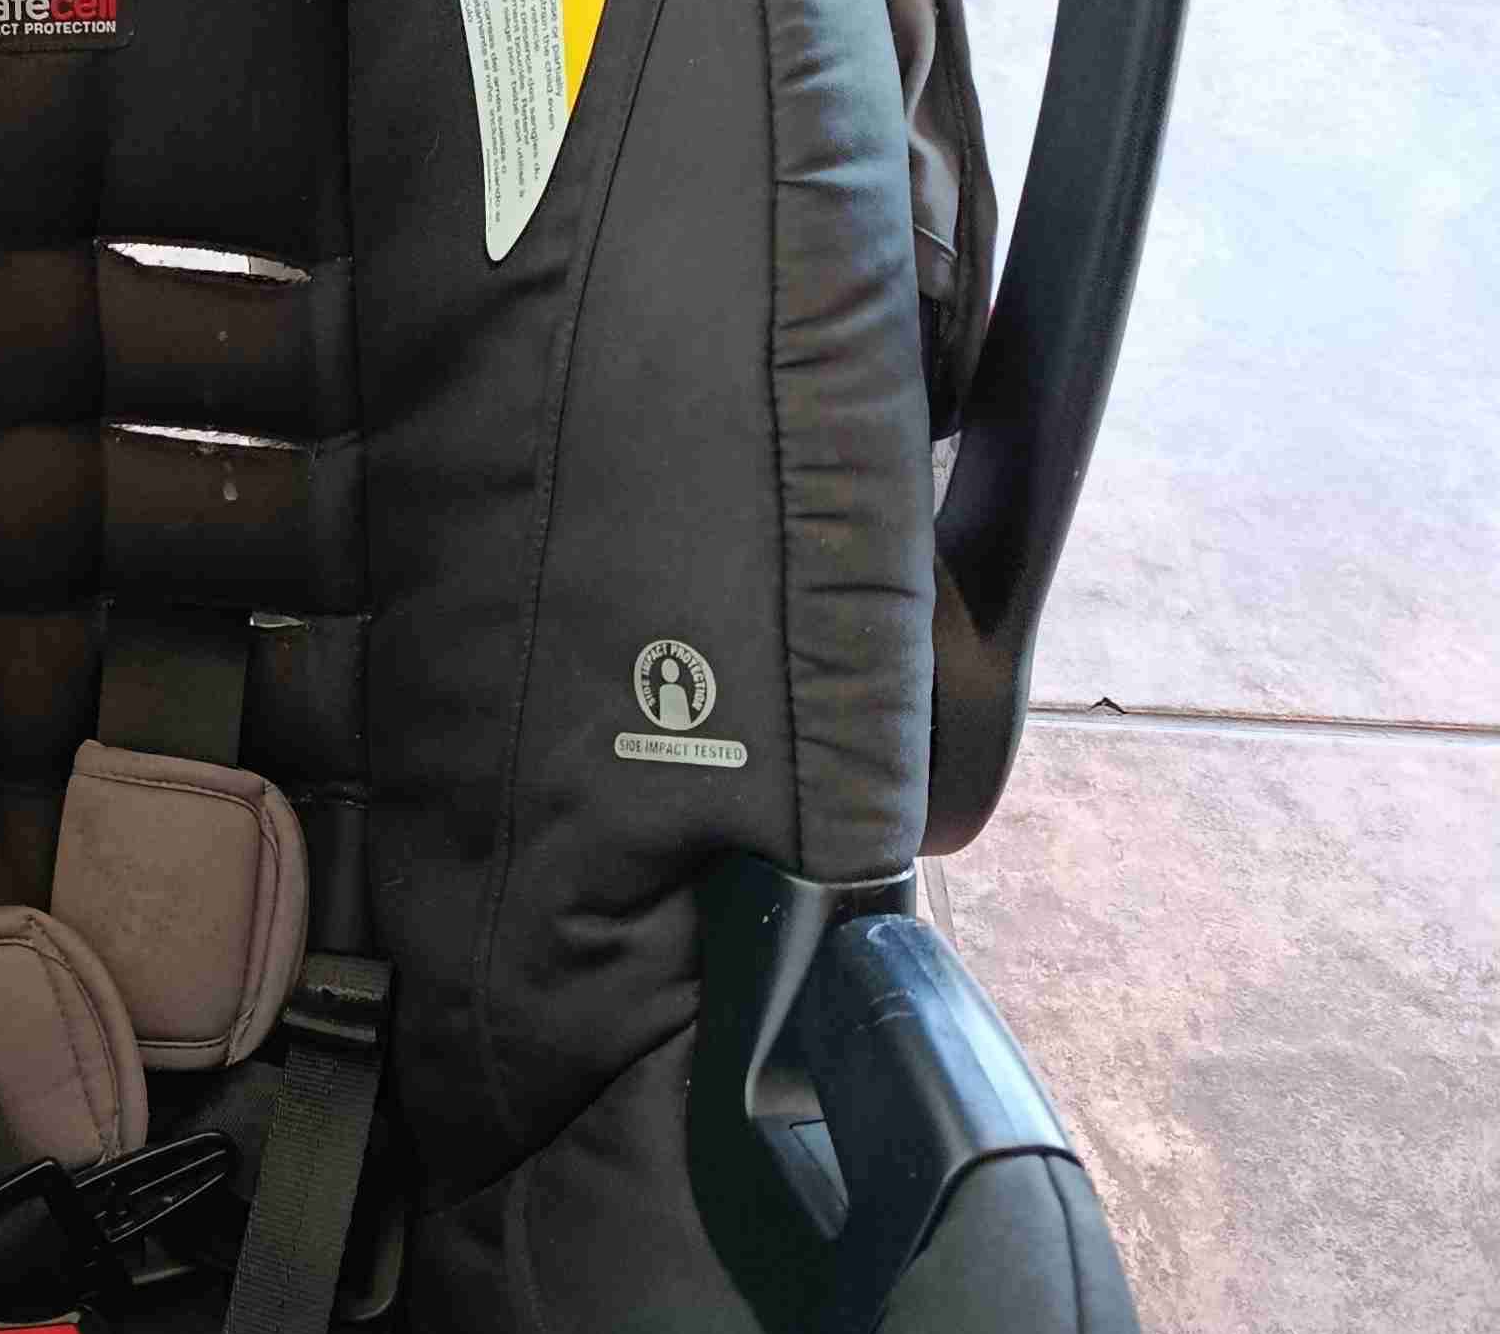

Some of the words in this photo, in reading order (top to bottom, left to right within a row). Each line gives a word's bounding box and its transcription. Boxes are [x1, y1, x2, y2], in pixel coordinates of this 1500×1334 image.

[24, 20, 117, 35] PROTECTION
[670, 643, 707, 711] PROTECTION
[618, 738, 642, 753] SIDE
[644, 740, 689, 757] IMPACT
[694, 744, 743, 762] TESTED
